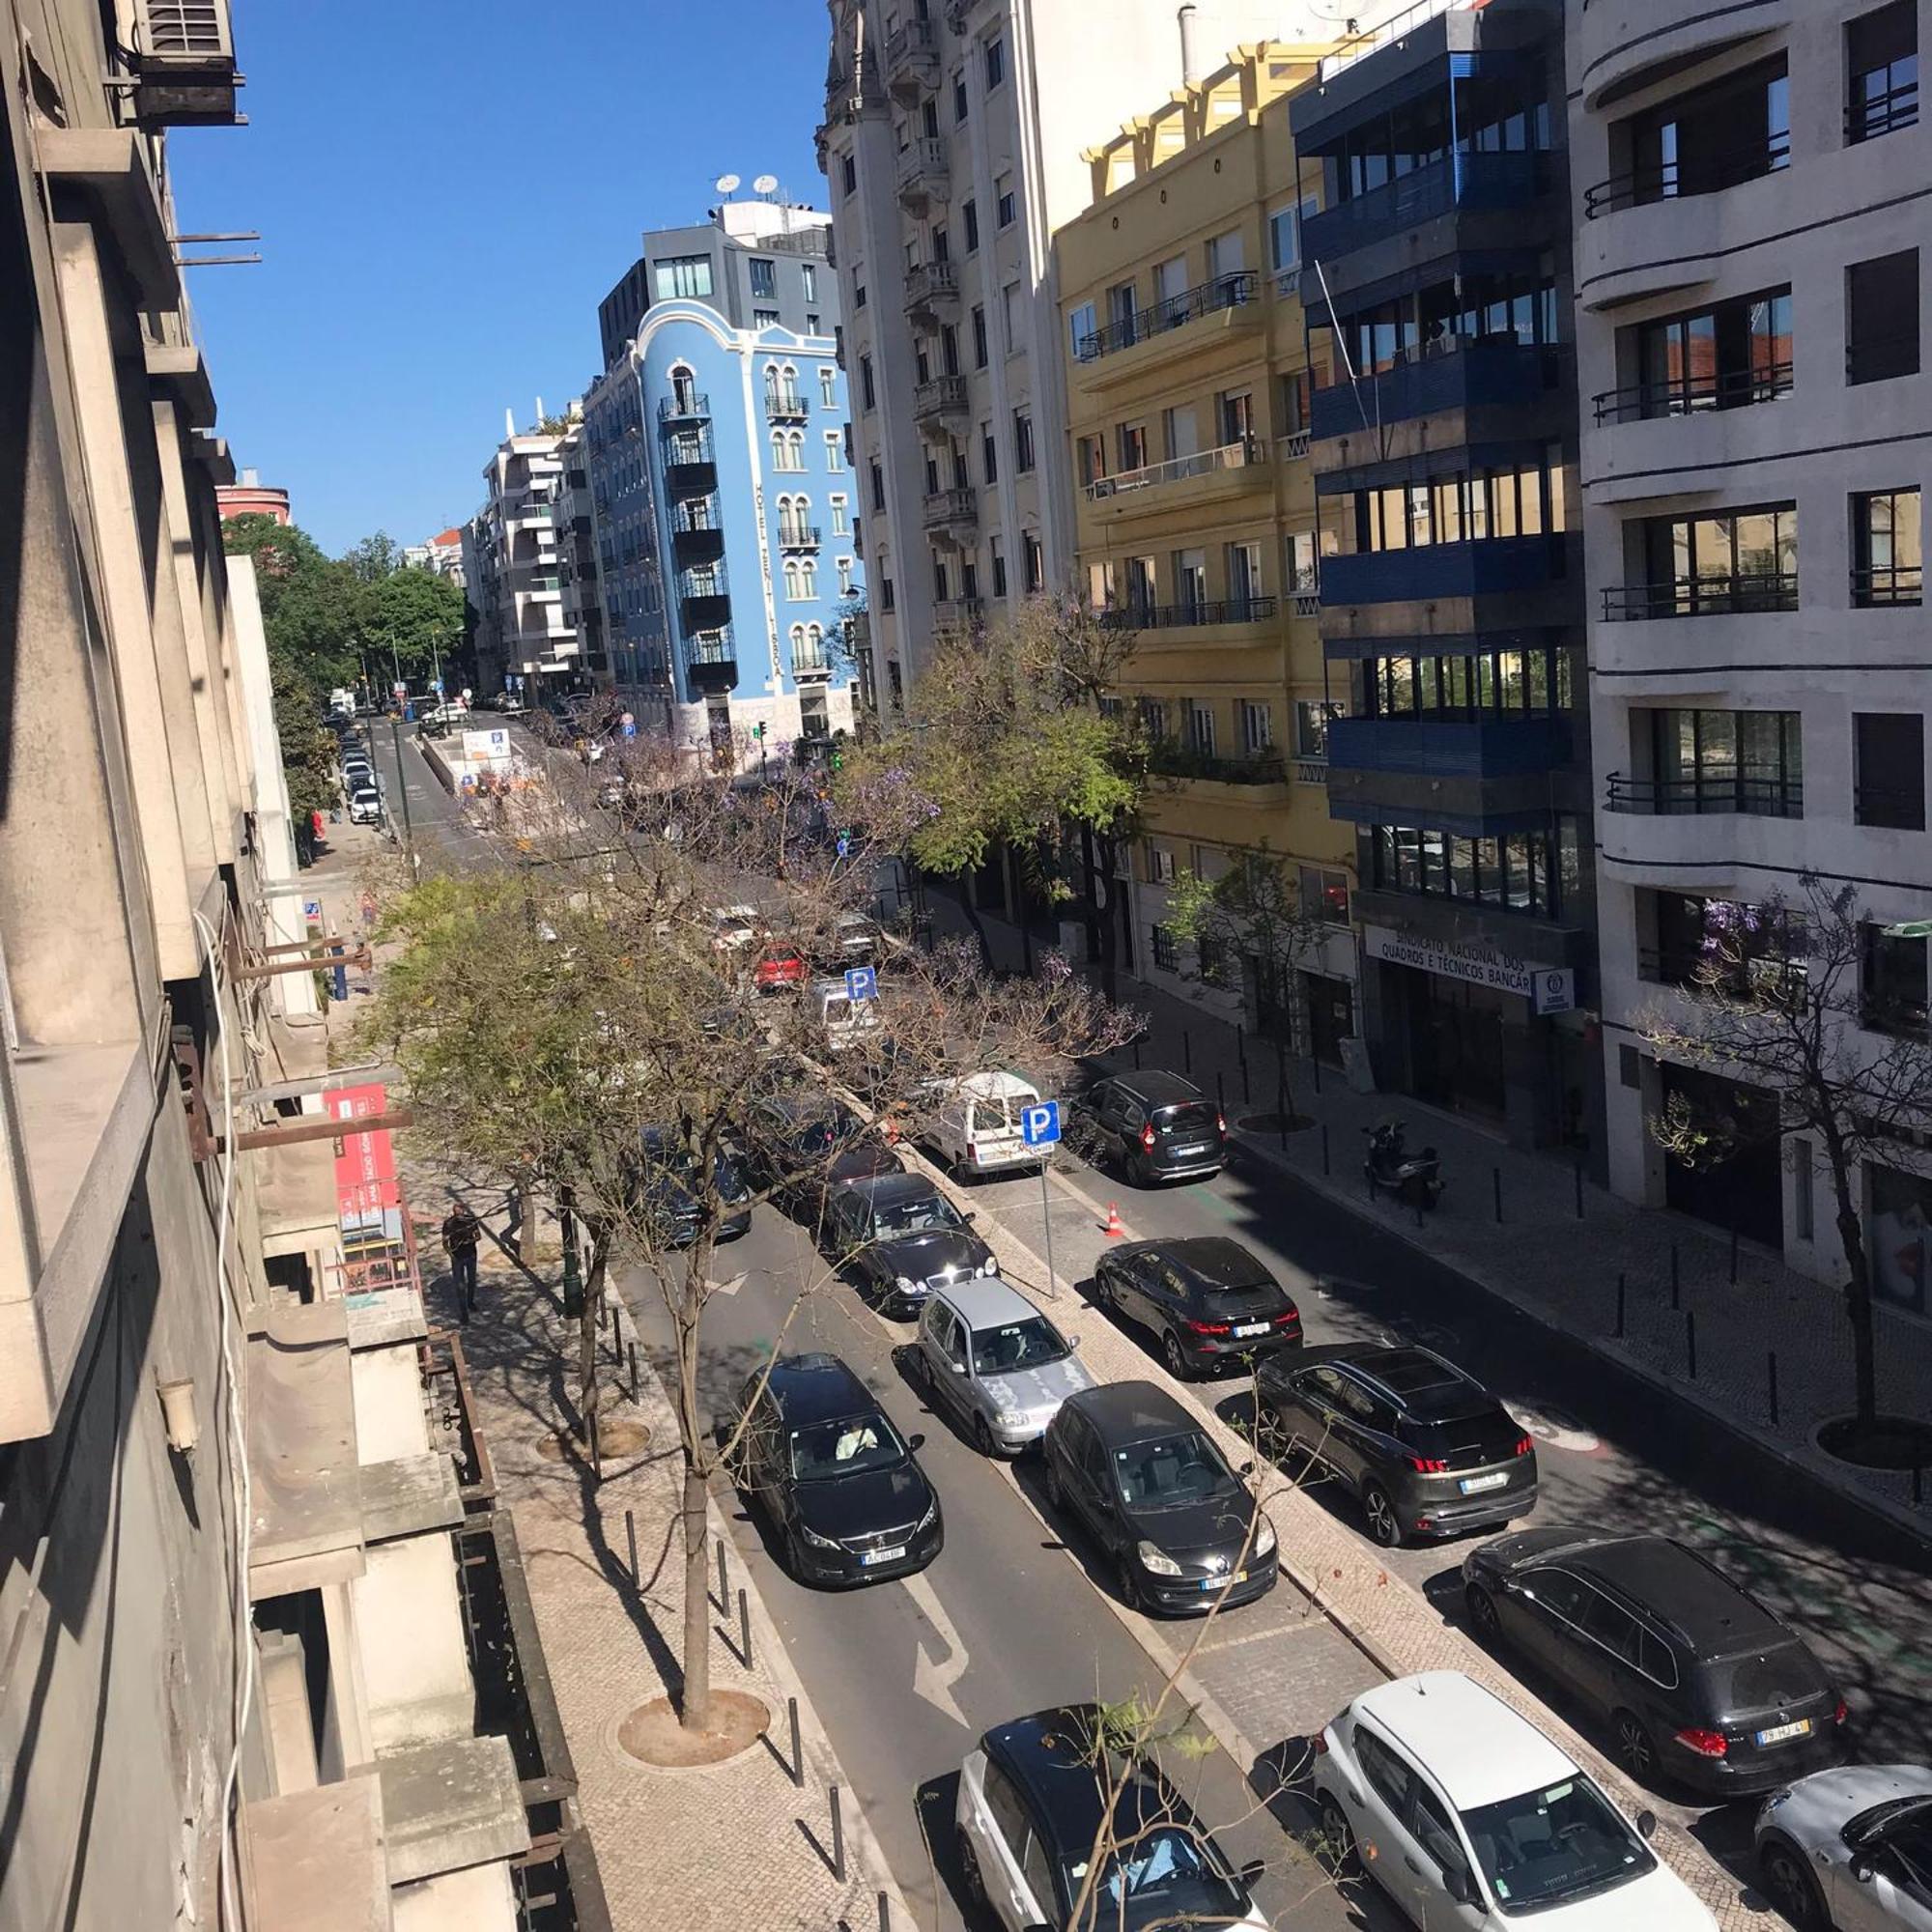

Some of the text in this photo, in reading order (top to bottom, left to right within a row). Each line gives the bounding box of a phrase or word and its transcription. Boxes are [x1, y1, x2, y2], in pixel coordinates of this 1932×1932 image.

[756, 483, 781, 677] HOTEL ZENIT LISBOA
[1381, 941, 1530, 991] QUADROS E TÉCNICOS BANCÁR
[1395, 930, 1524, 972] SINDICATO NACIONAL DOS
[852, 972, 869, 997] P
[1030, 1108, 1051, 1142] P
